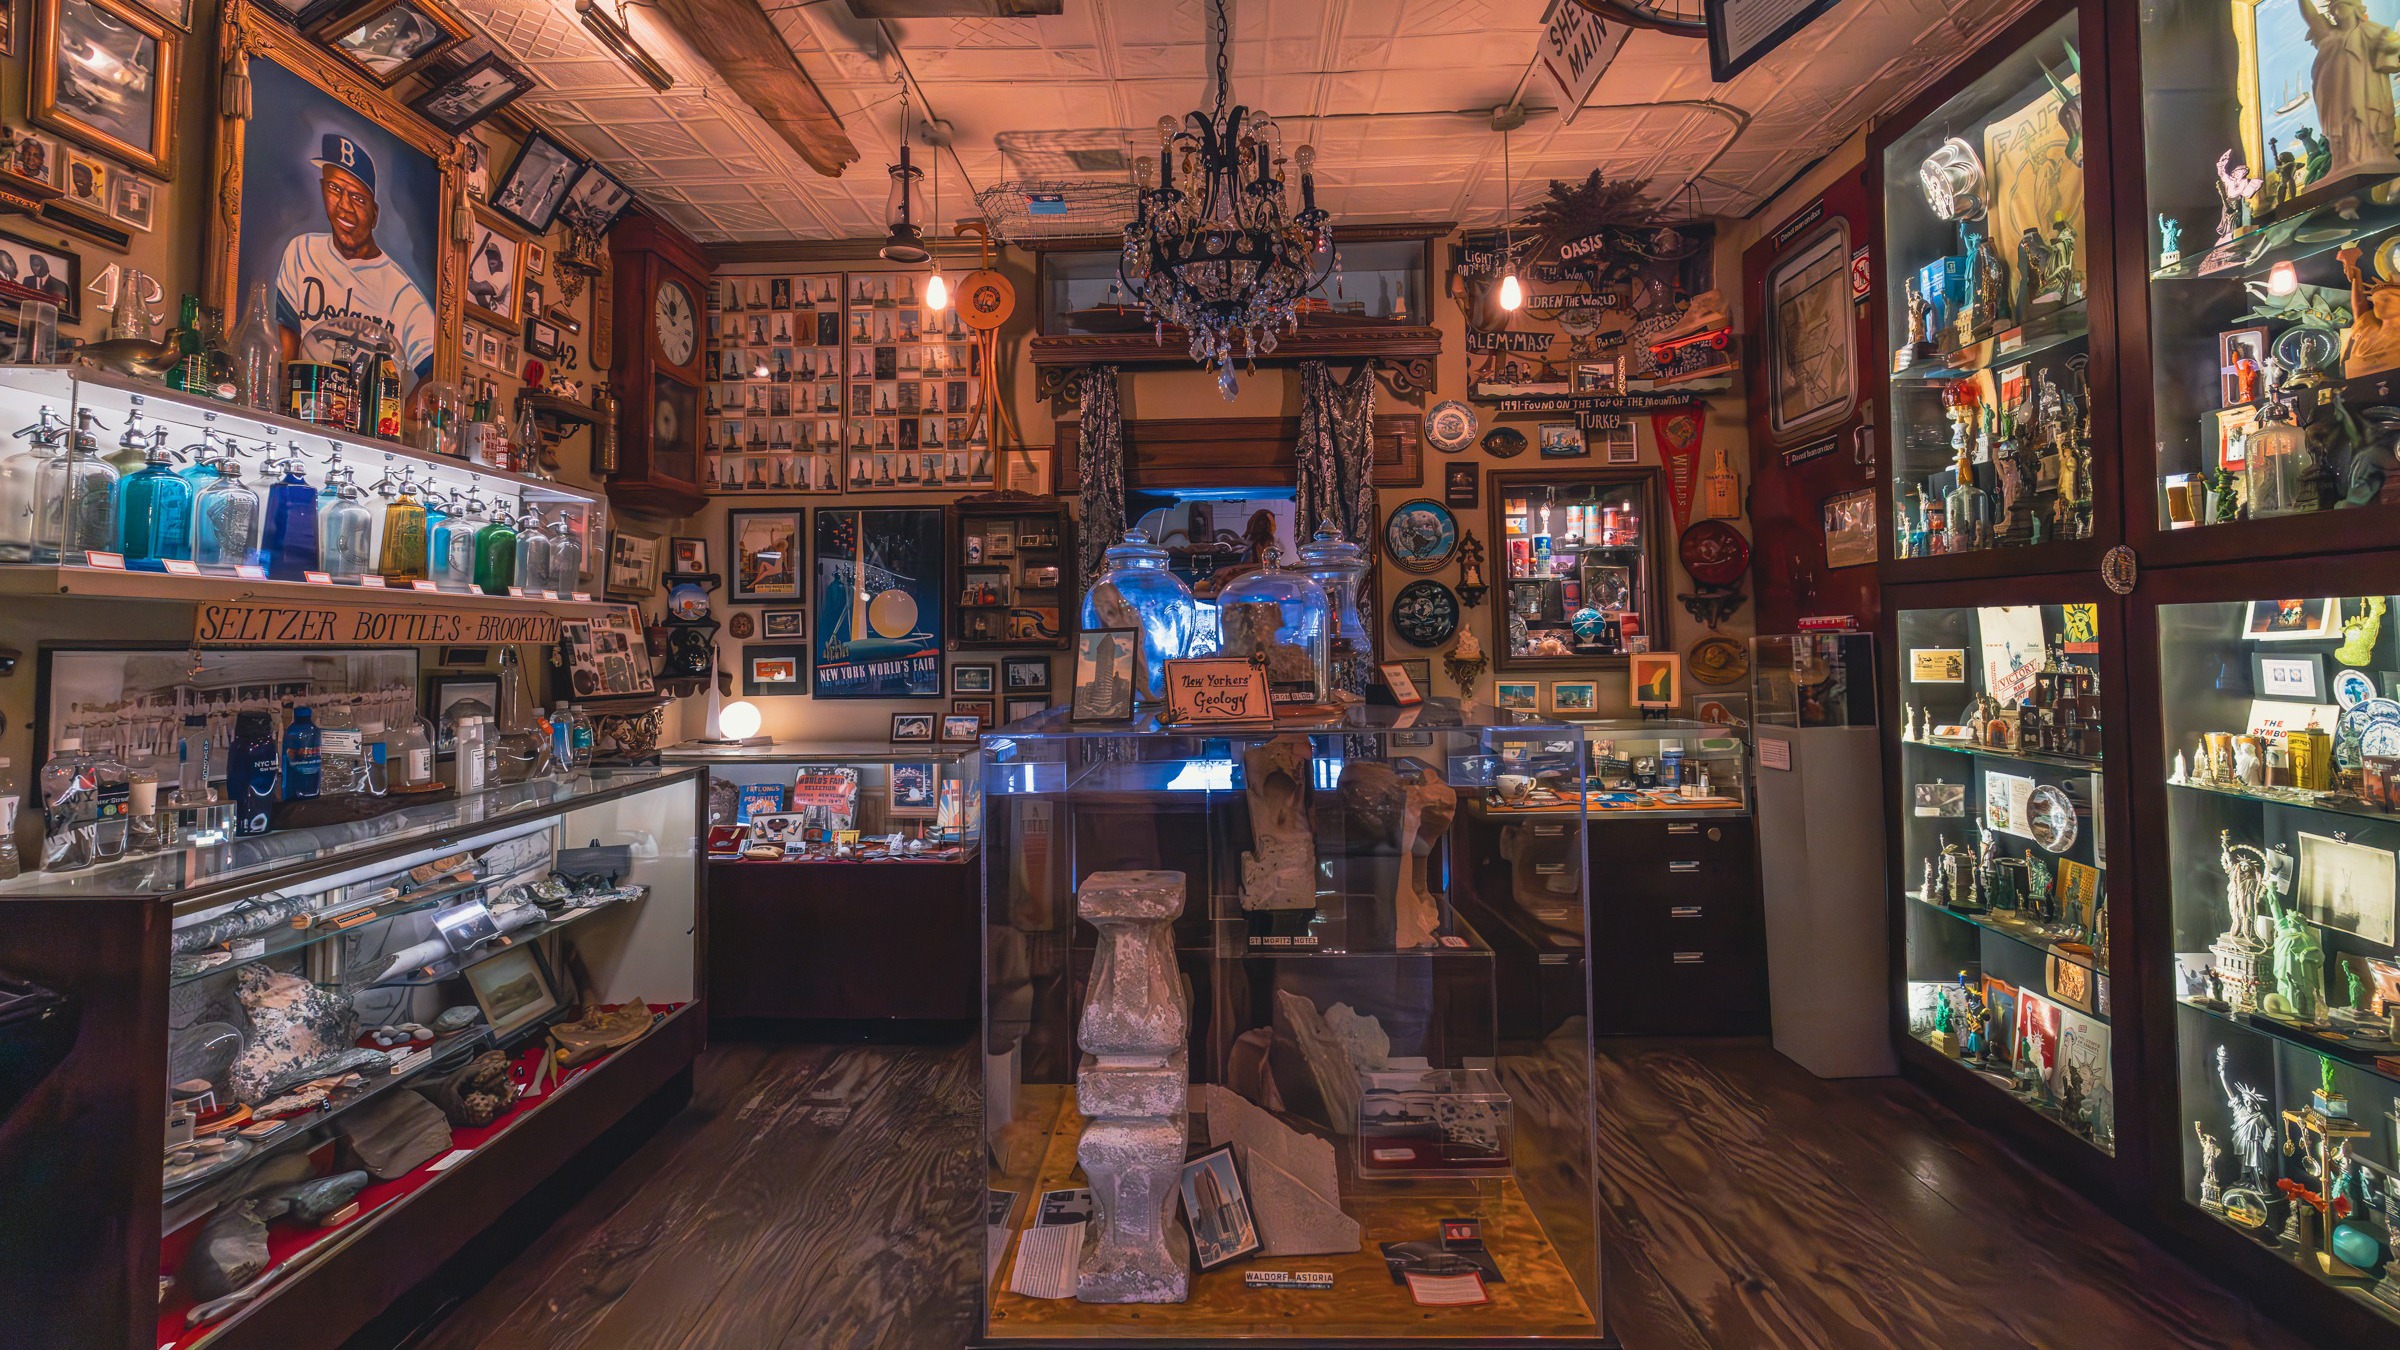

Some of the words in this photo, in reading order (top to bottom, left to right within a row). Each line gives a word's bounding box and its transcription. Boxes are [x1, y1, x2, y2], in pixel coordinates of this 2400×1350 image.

[1549, 0, 1585, 57] SHE
[1568, 14, 1608, 83] MAIN
[339, 137, 356, 168] B
[1565, 294, 1580, 308] THE
[556, 340, 578, 371] 42
[1556, 399, 1571, 410] ON
[1573, 398, 1593, 409] THE
[1627, 396, 1644, 408] THE
[200, 605, 337, 641] SELTZER
[352, 611, 460, 643] BOTTLES
[476, 616, 561, 643] BROOKLYN
[819, 669, 838, 683] NEW
[840, 665, 866, 681] YORK
[868, 660, 910, 677] WORLD'S
[912, 657, 936, 672] FAIR
[1999, 660, 2036, 687] VICTORY
[1181, 675, 1204, 687] New
[1194, 690, 1249, 713] Geology
[2252, 727, 2288, 738] SYMBO
[2264, 719, 2284, 728] THE
[829, 776, 845, 785] FAIR
[322, 1100, 330, 1110] 5
[1246, 1272, 1288, 1281] WALDORF
[1296, 1273, 1333, 1282] ASTORIA
